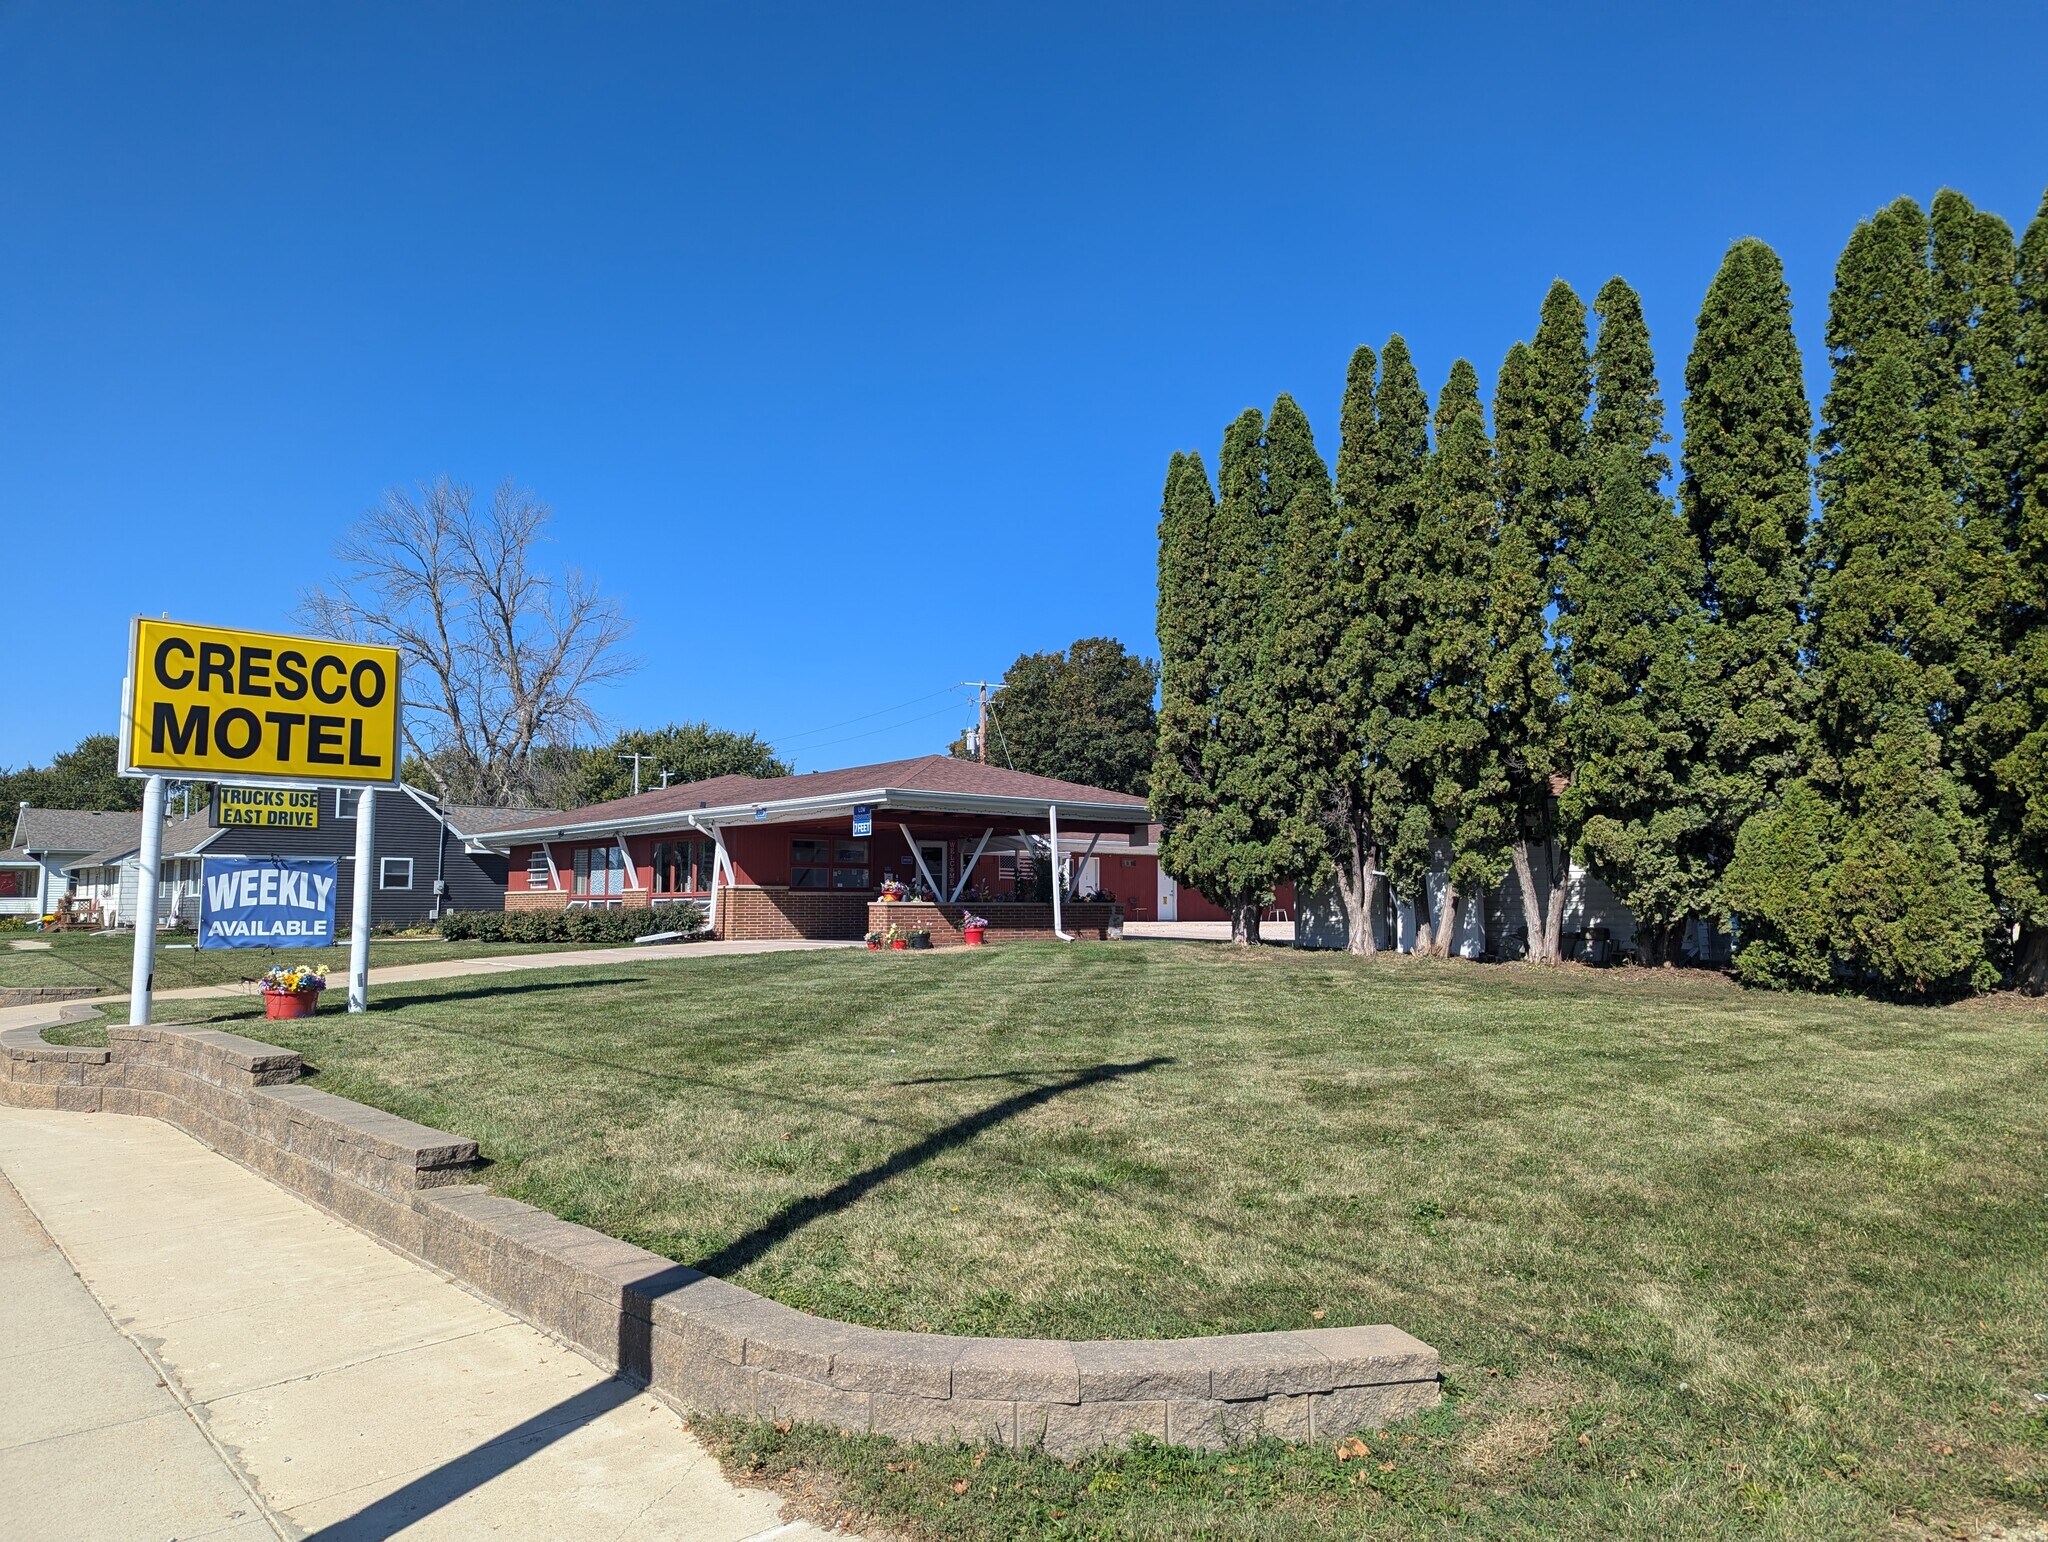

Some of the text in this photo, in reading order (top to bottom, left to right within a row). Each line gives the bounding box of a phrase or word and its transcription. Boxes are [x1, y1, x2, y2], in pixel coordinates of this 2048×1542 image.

[154, 637, 386, 708] CRESCO
[151, 702, 382, 767] MOTEL
[221, 789, 317, 808] TRUCKS USE
[223, 808, 314, 827] EAST DRIVE
[207, 868, 334, 913] WEEKLY
[208, 920, 327, 937] AVAILABLE
